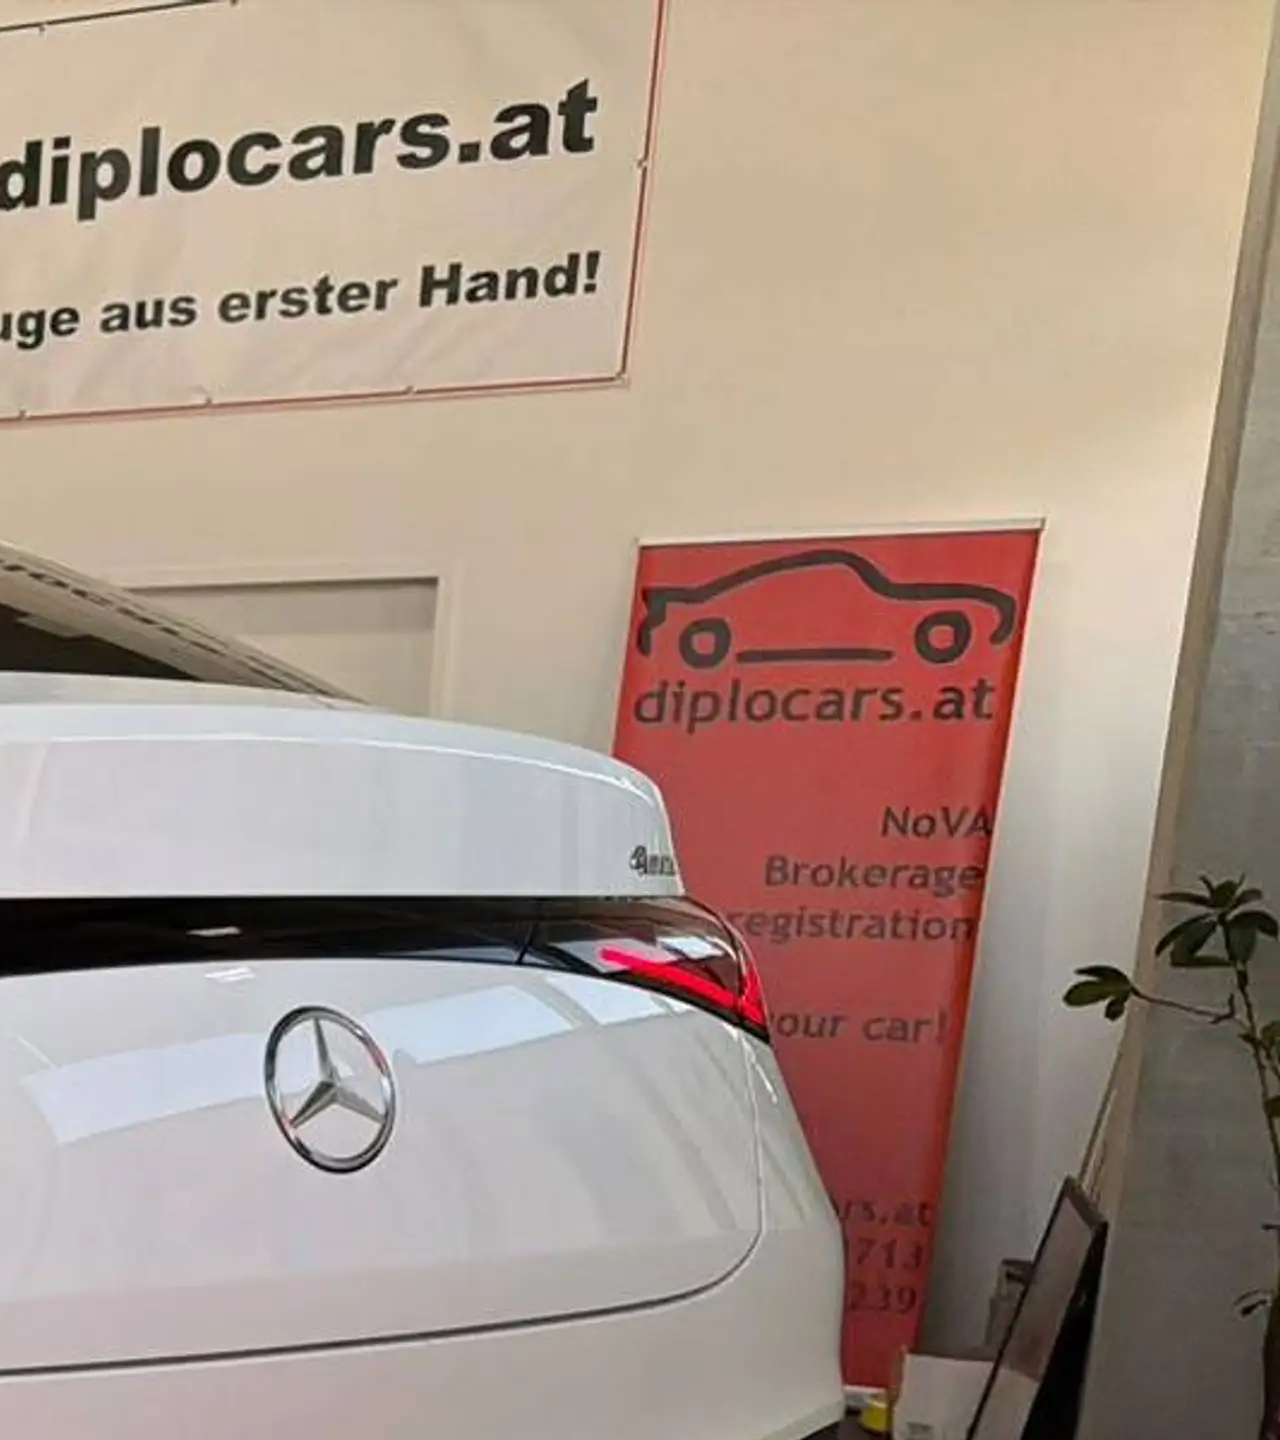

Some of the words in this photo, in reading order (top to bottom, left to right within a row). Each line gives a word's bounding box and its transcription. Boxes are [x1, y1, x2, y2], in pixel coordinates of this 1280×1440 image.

[99, 294, 197, 334] aus
[218, 274, 399, 324] erster
[418, 251, 601, 308] Hand!
[633, 678, 995, 734] diplocars.at
[880, 805, 993, 838] NoVA
[765, 854, 986, 898] Brokerage
[863, 1008, 948, 1042] car!
